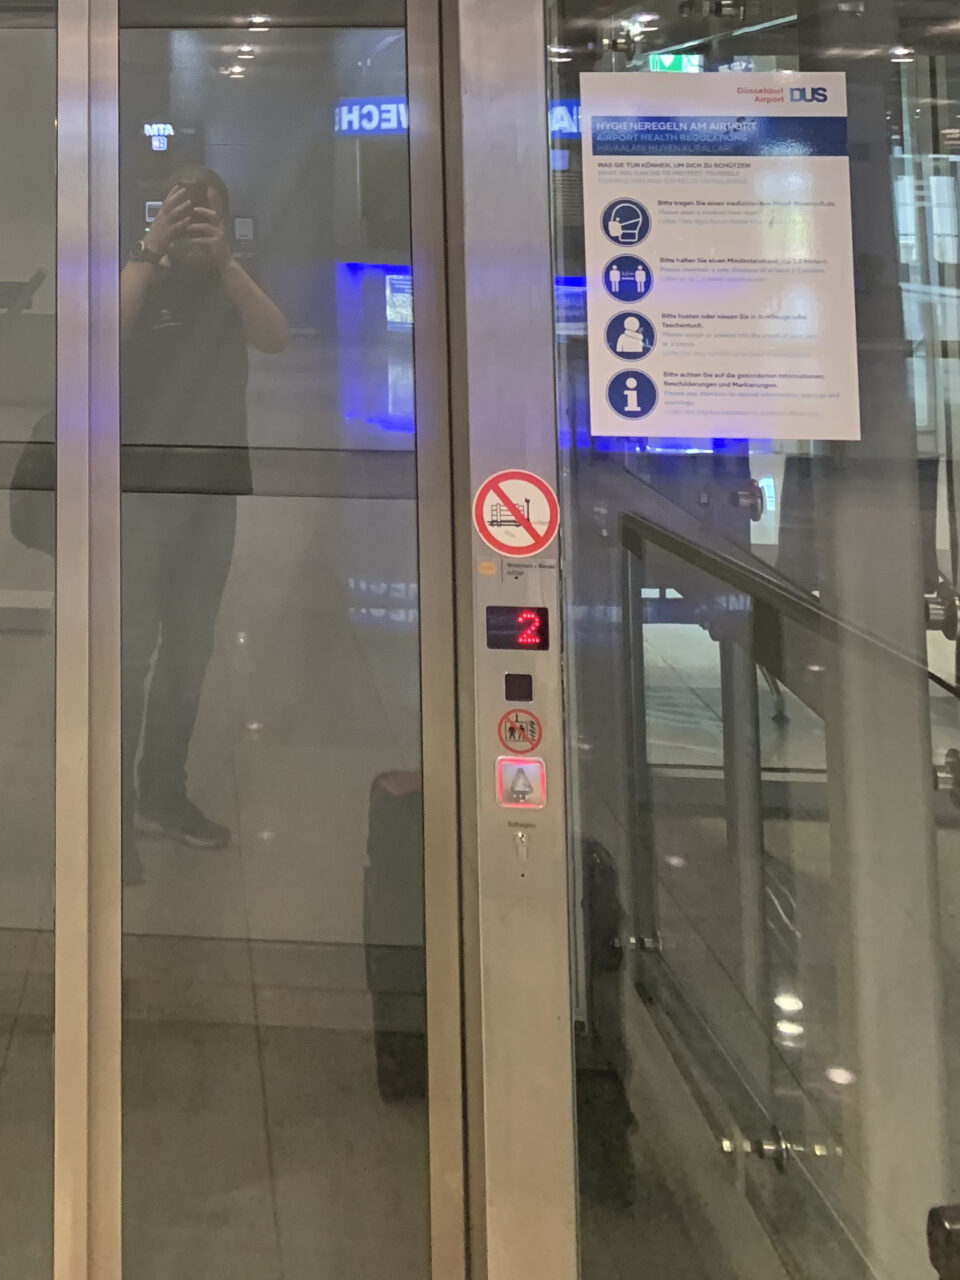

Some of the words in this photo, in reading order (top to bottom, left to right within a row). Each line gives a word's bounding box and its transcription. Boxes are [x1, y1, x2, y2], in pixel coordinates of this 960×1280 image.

[754, 96, 785, 104] Airport
[789, 86, 828, 103] DUS
[595, 121, 688, 132] HYGIENEREGELN
[690, 122, 707, 131] AM
[709, 121, 758, 132] AIRPORT
[596, 133, 639, 142] AIRPORT
[640, 133, 678, 142] HEALTH
[680, 133, 749, 143] REGULATIONS
[518, 611, 540, 644] 2
